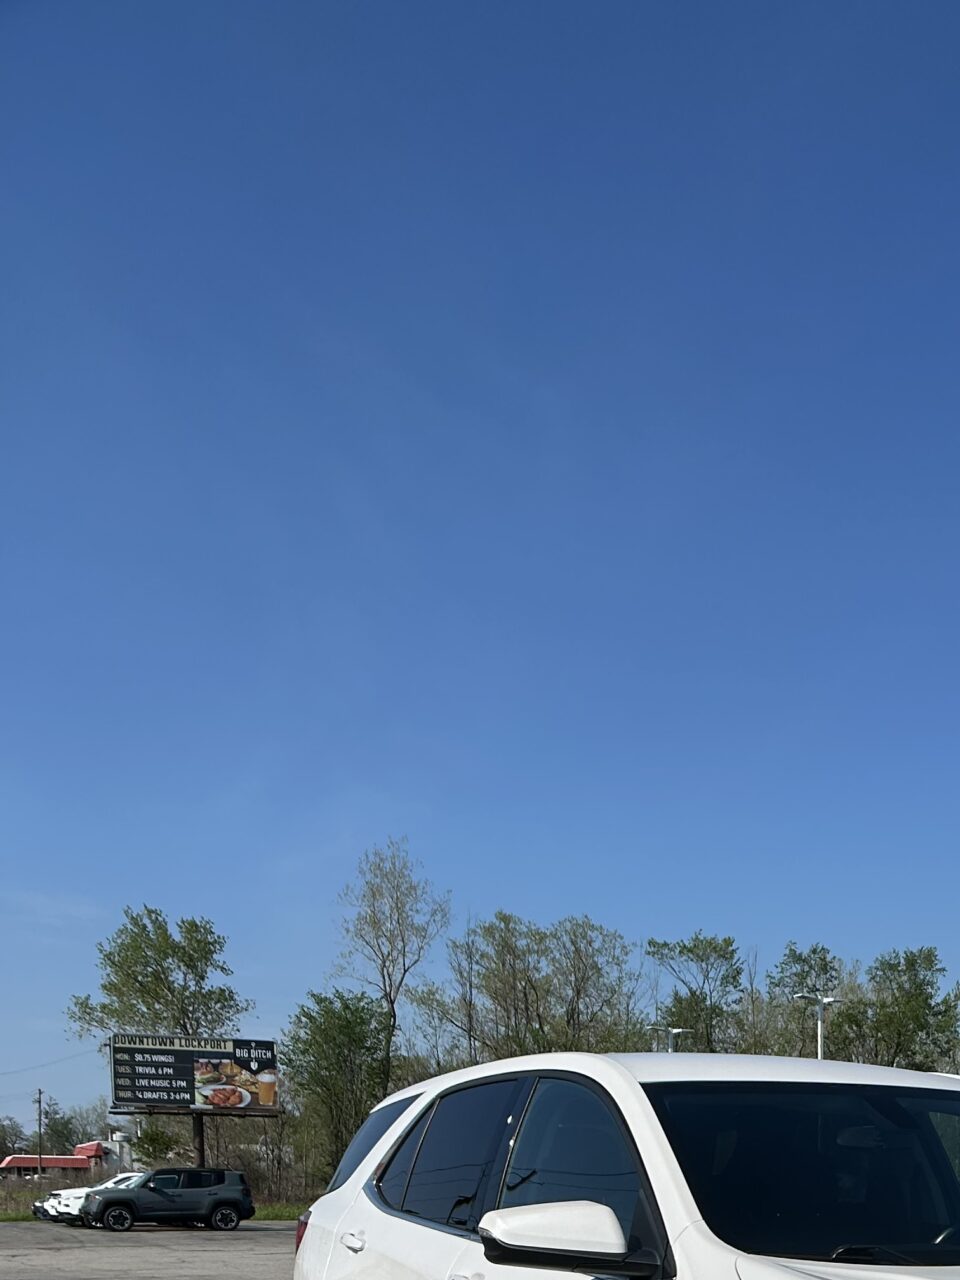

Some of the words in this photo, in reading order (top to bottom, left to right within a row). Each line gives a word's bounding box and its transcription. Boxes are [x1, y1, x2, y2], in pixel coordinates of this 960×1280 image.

[114, 1034, 175, 1048] DOWNTOWN
[178, 1038, 228, 1050] LOCKPORT
[235, 1048, 248, 1058] BIG
[250, 1049, 272, 1059] DITCH
[135, 1066, 157, 1075] TRIVIA
[135, 1078, 149, 1087] LIVE
[150, 1079, 171, 1088] MUSIC
[143, 1091, 168, 1100] DRAFTS
